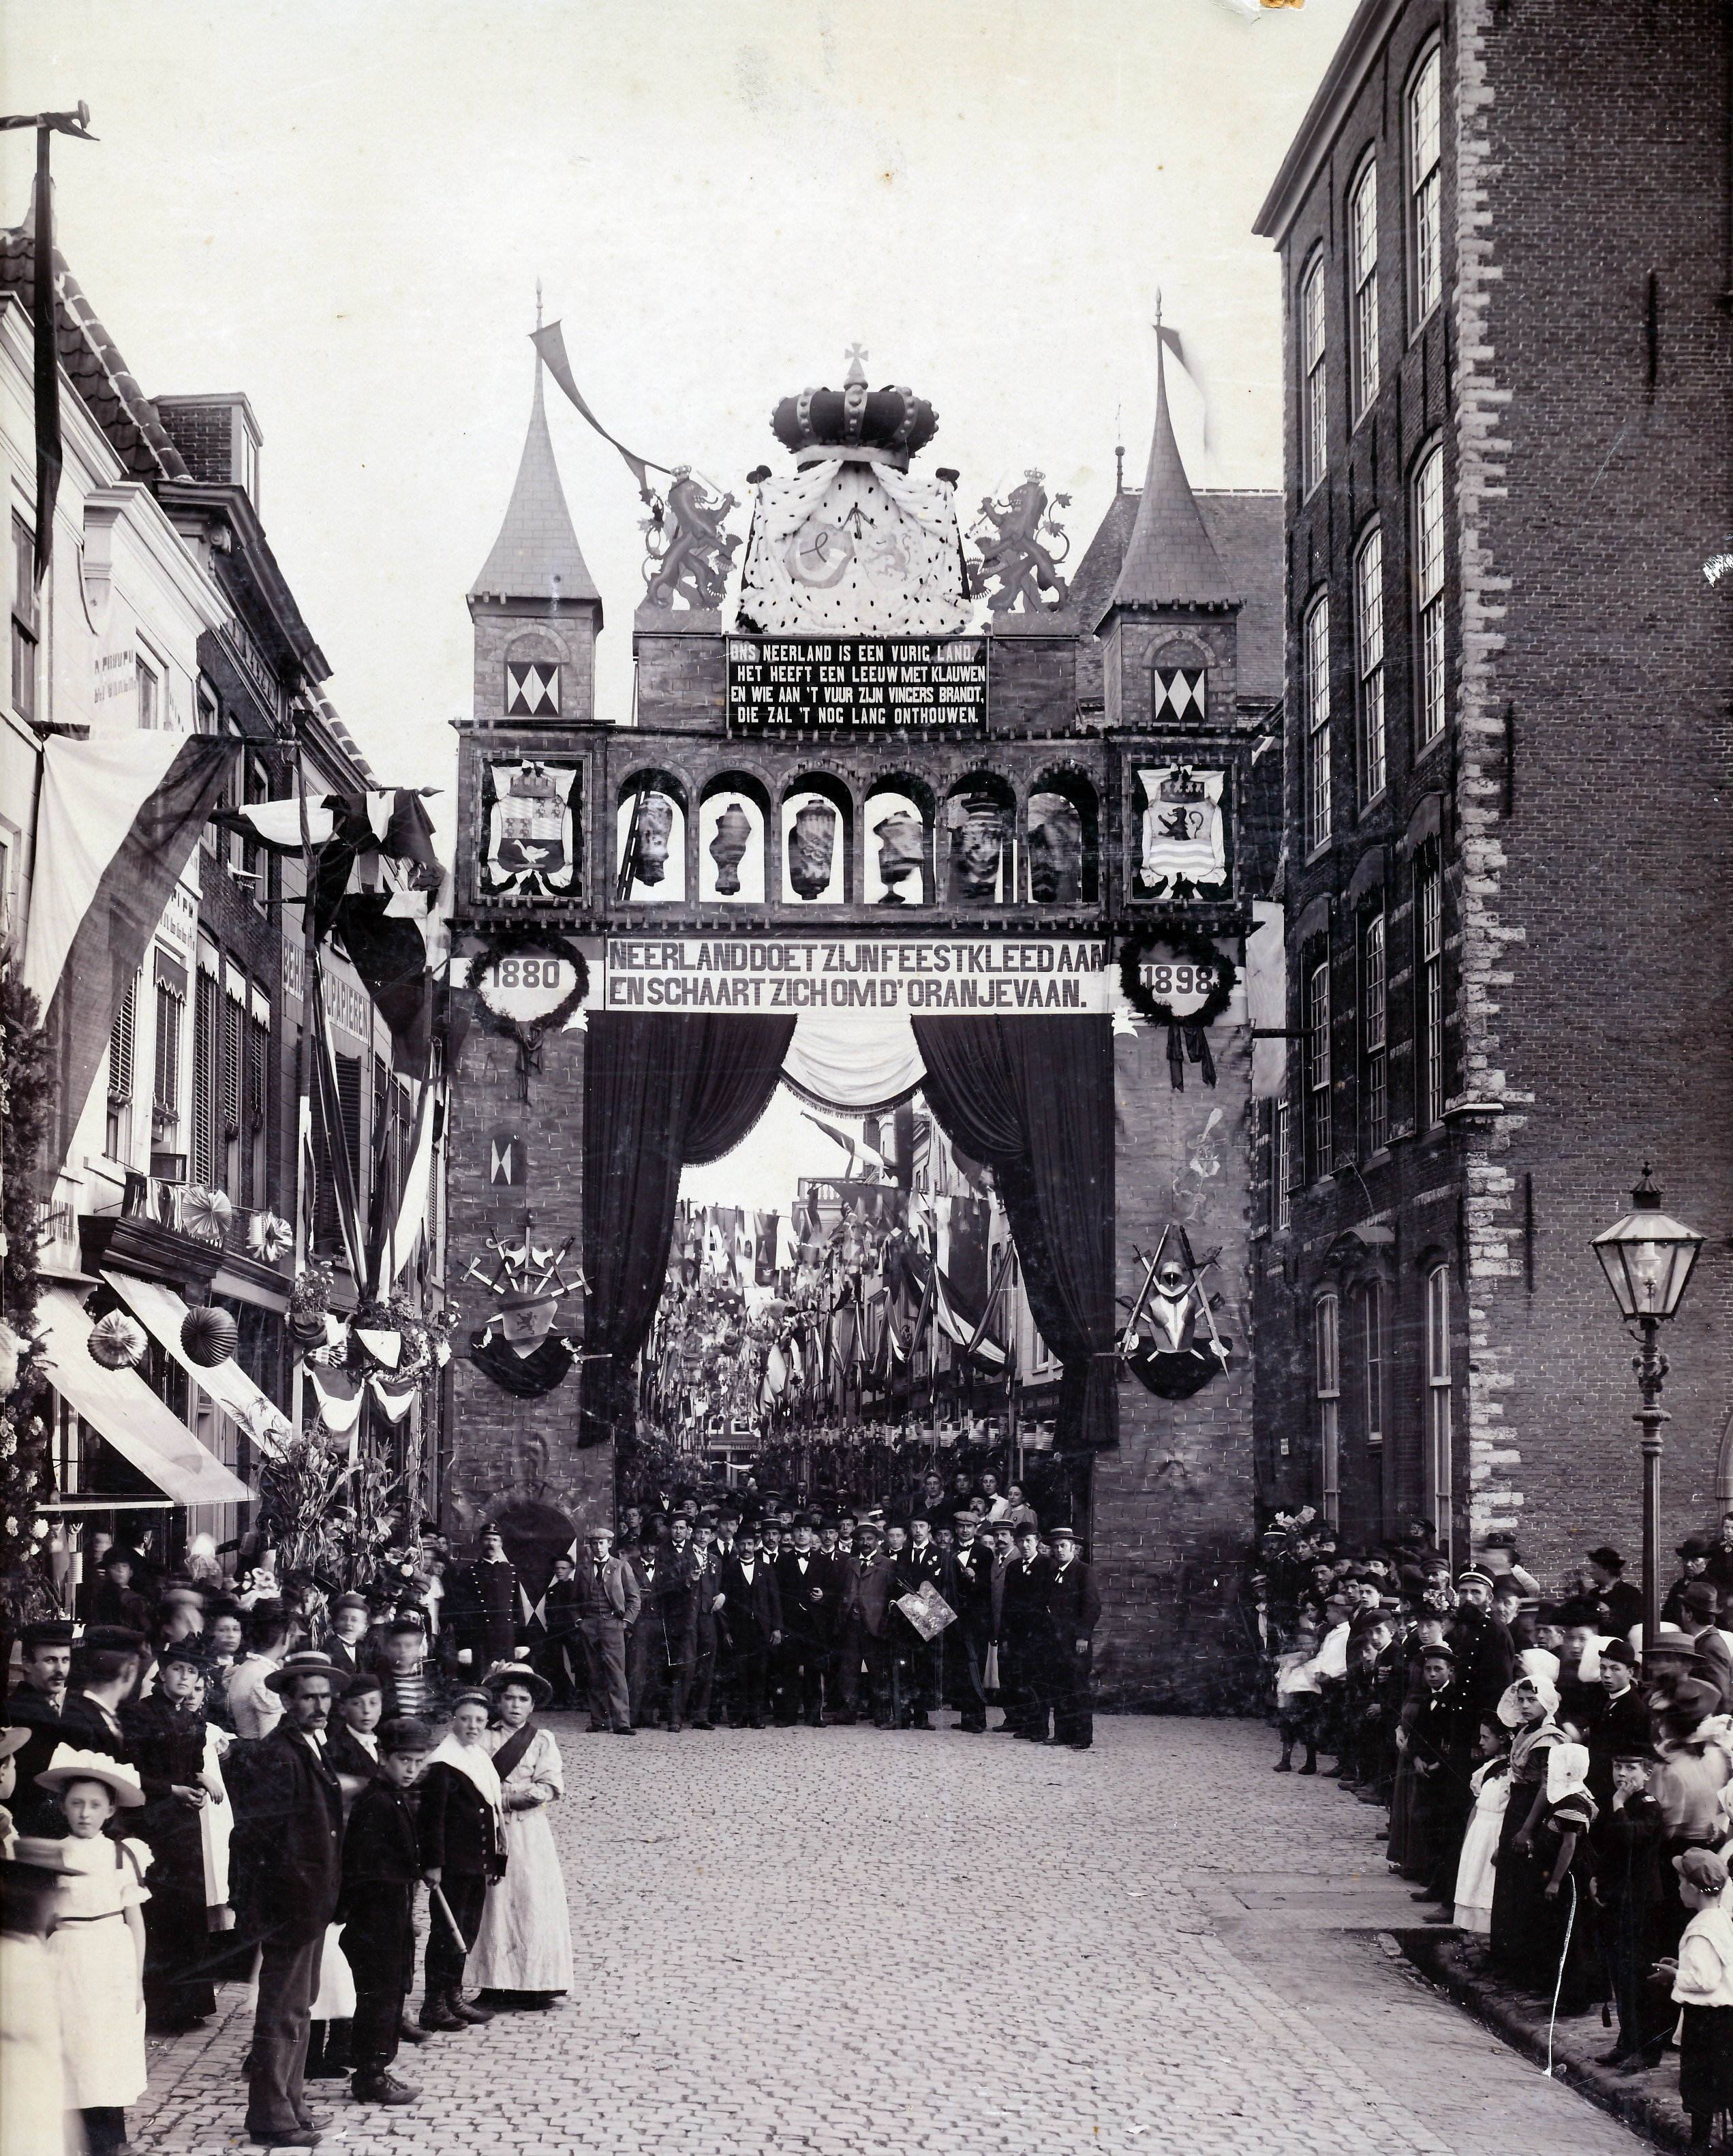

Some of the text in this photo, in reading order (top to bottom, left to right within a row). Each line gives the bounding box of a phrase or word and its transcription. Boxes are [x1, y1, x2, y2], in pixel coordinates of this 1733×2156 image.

[731, 644, 975, 663] ONS NEERLAND IS EEN VURIG LAND,
[737, 665, 985, 682] HET HEEFT EEN LEEUW MET KLAUWEN
[731, 686, 984, 703] EN WIE AAN 'T VUUR ZIJN VINGERS BRANDT,
[737, 706, 979, 724] DIE ZAL 'T NOG LANG ONTHOUWEN.
[610, 942, 1105, 973] NEERLAND DOET ZIJN FEESTKLEED AAN
[493, 960, 560, 989] 1880
[1144, 965, 1213, 995] 1898
[609, 976, 645, 1005] EN
[647, 977, 766, 1006] SCHAART
[769, 978, 827, 1007] ZICH
[831, 979, 877, 1007] OM
[1013, 979, 1087, 1007] VAAN.
